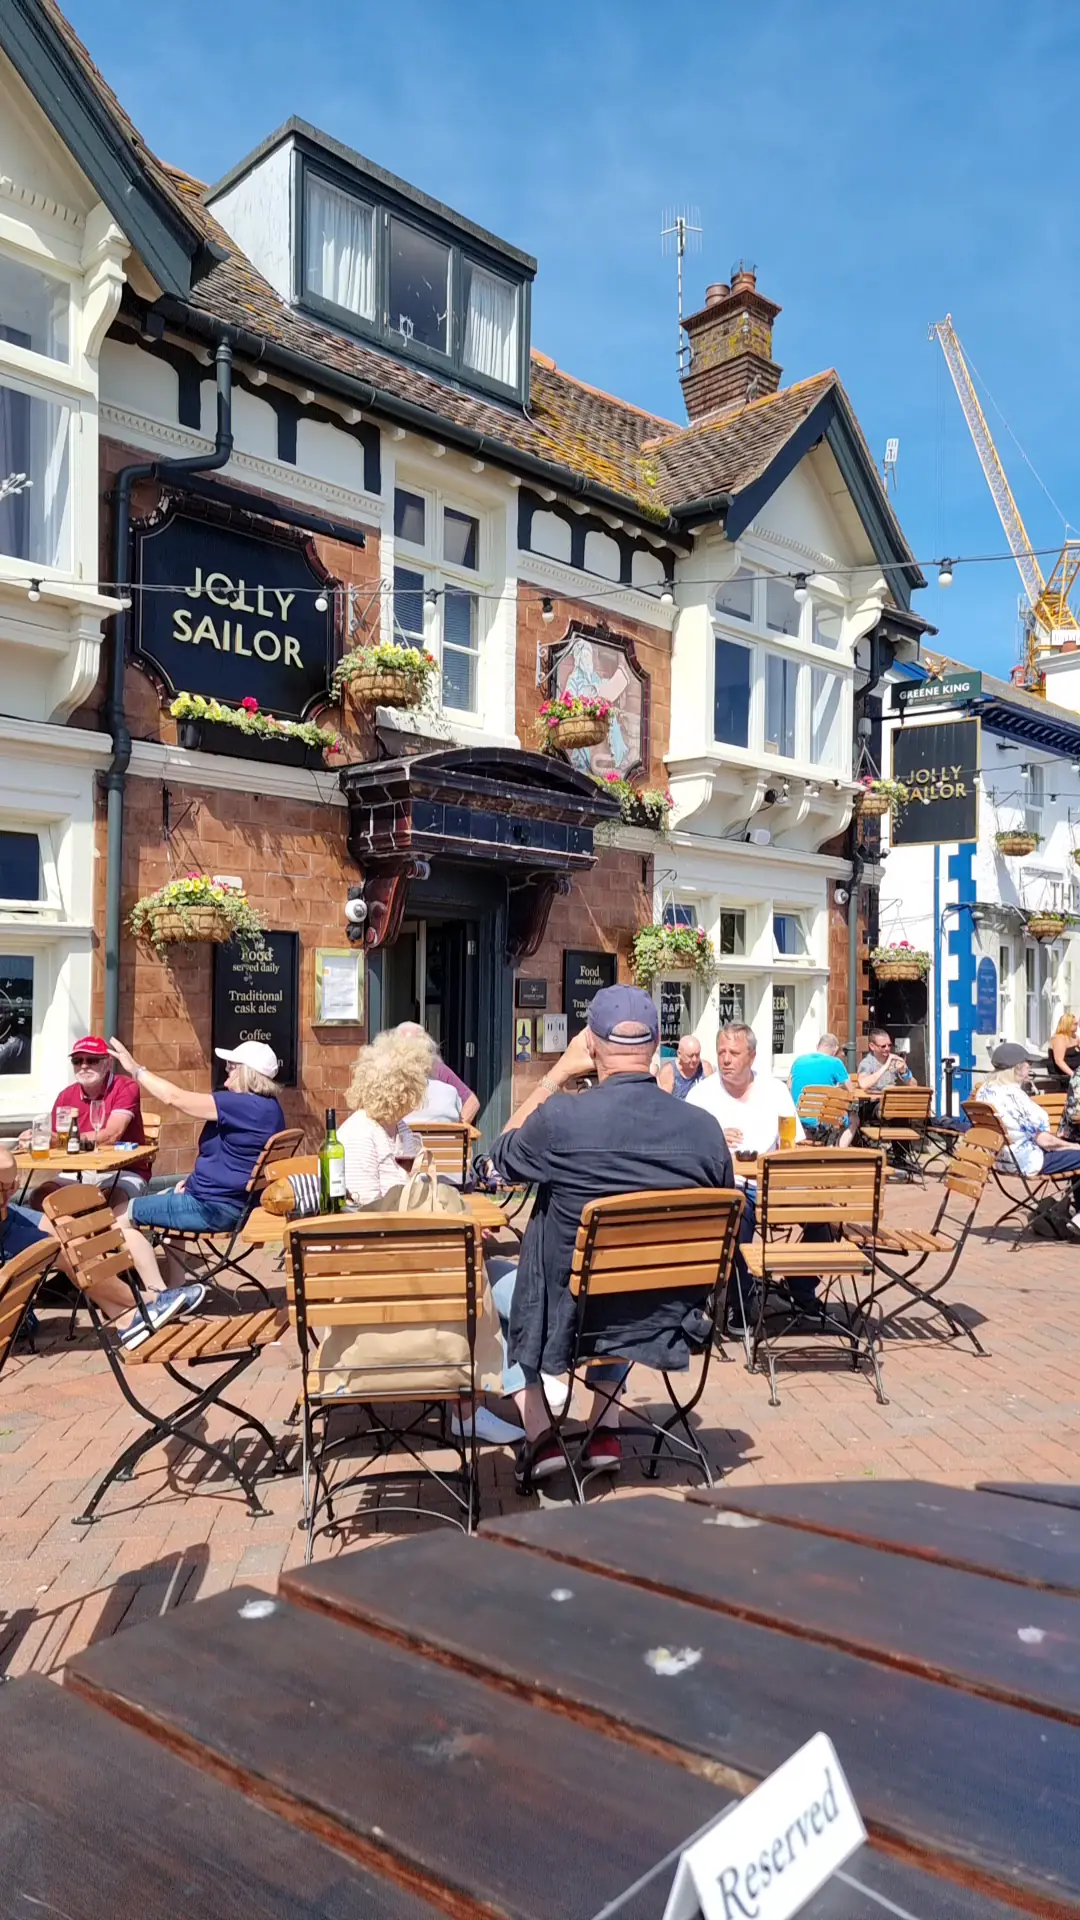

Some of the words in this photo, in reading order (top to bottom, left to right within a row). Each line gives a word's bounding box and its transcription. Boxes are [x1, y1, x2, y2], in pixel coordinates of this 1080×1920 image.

[184, 566, 296, 623] JOLLY
[172, 608, 304, 669] SAILOR
[899, 686, 940, 700] GREENE
[942, 682, 970, 695] KING
[906, 765, 962, 785] JOLLY
[232, 962, 259, 972] served
[260, 962, 280, 975] daily
[580, 965, 600, 977] Food
[228, 990, 283, 1002] Traditional
[234, 1002, 257, 1014] cask
[258, 1003, 277, 1014] ales
[662, 1003, 685, 1013] RAFT
[773, 997, 789, 1010] EERS
[239, 1029, 272, 1041] Coffee
[715, 1765, 840, 1920] Reserved
